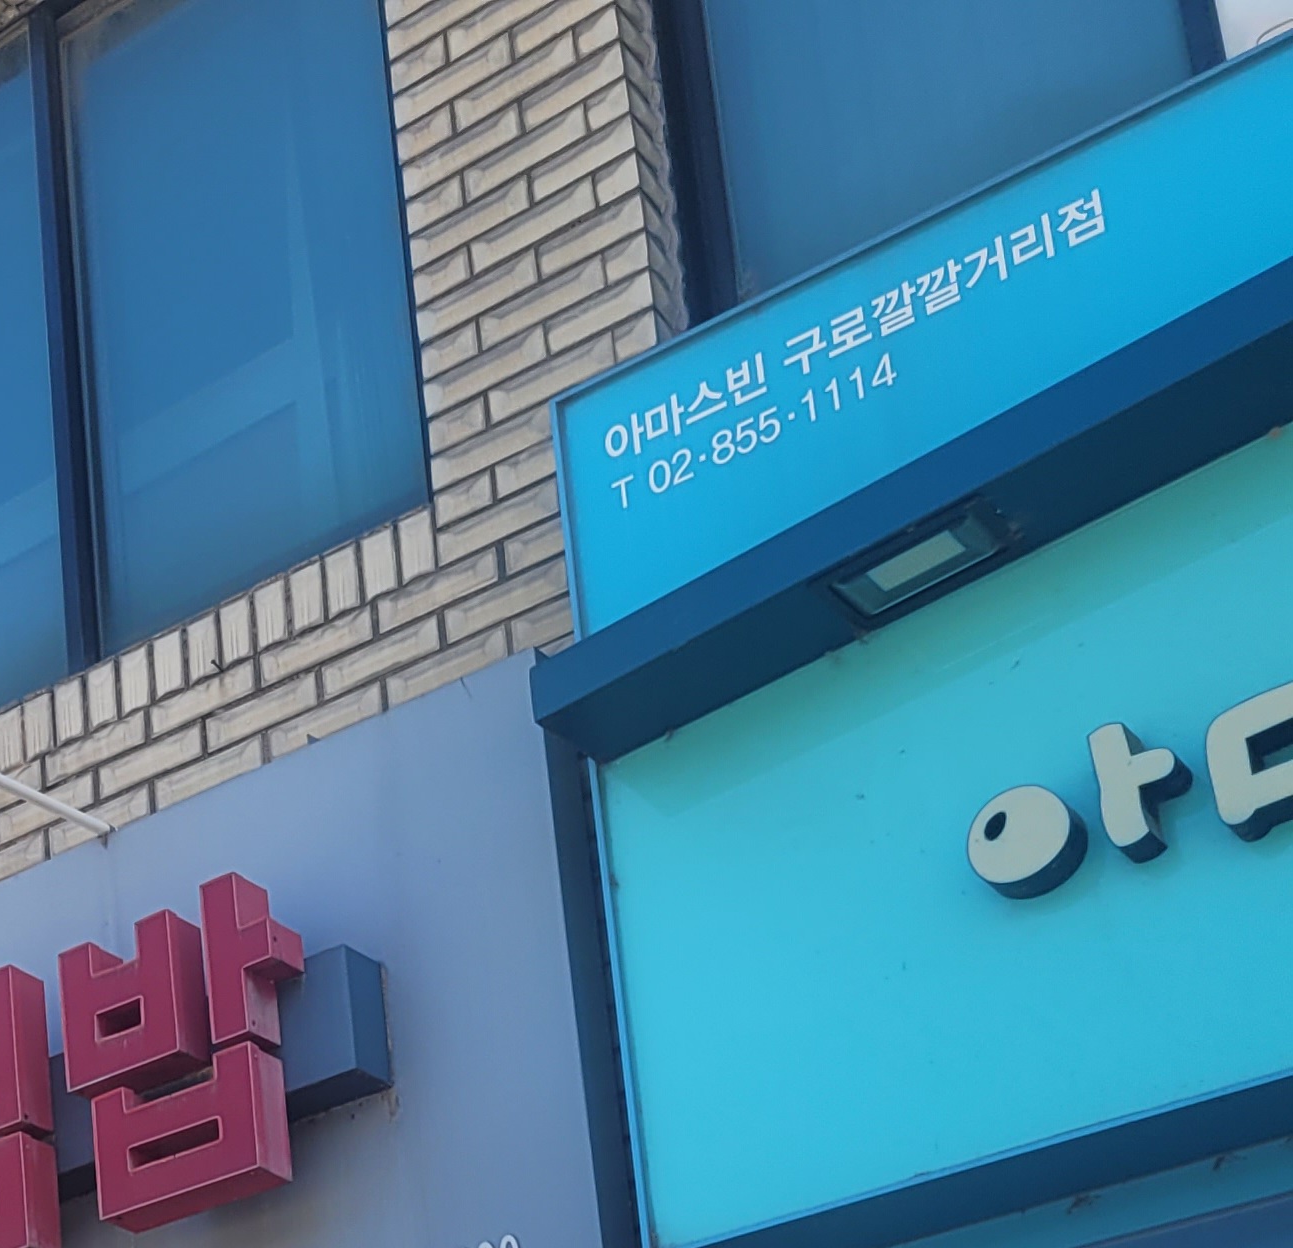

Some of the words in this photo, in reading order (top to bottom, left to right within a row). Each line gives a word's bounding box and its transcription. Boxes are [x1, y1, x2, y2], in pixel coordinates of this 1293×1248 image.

[605, 351, 768, 457] 아마스빈
[782, 187, 1107, 375] 구로깔깔거리점
[610, 474, 635, 510] T
